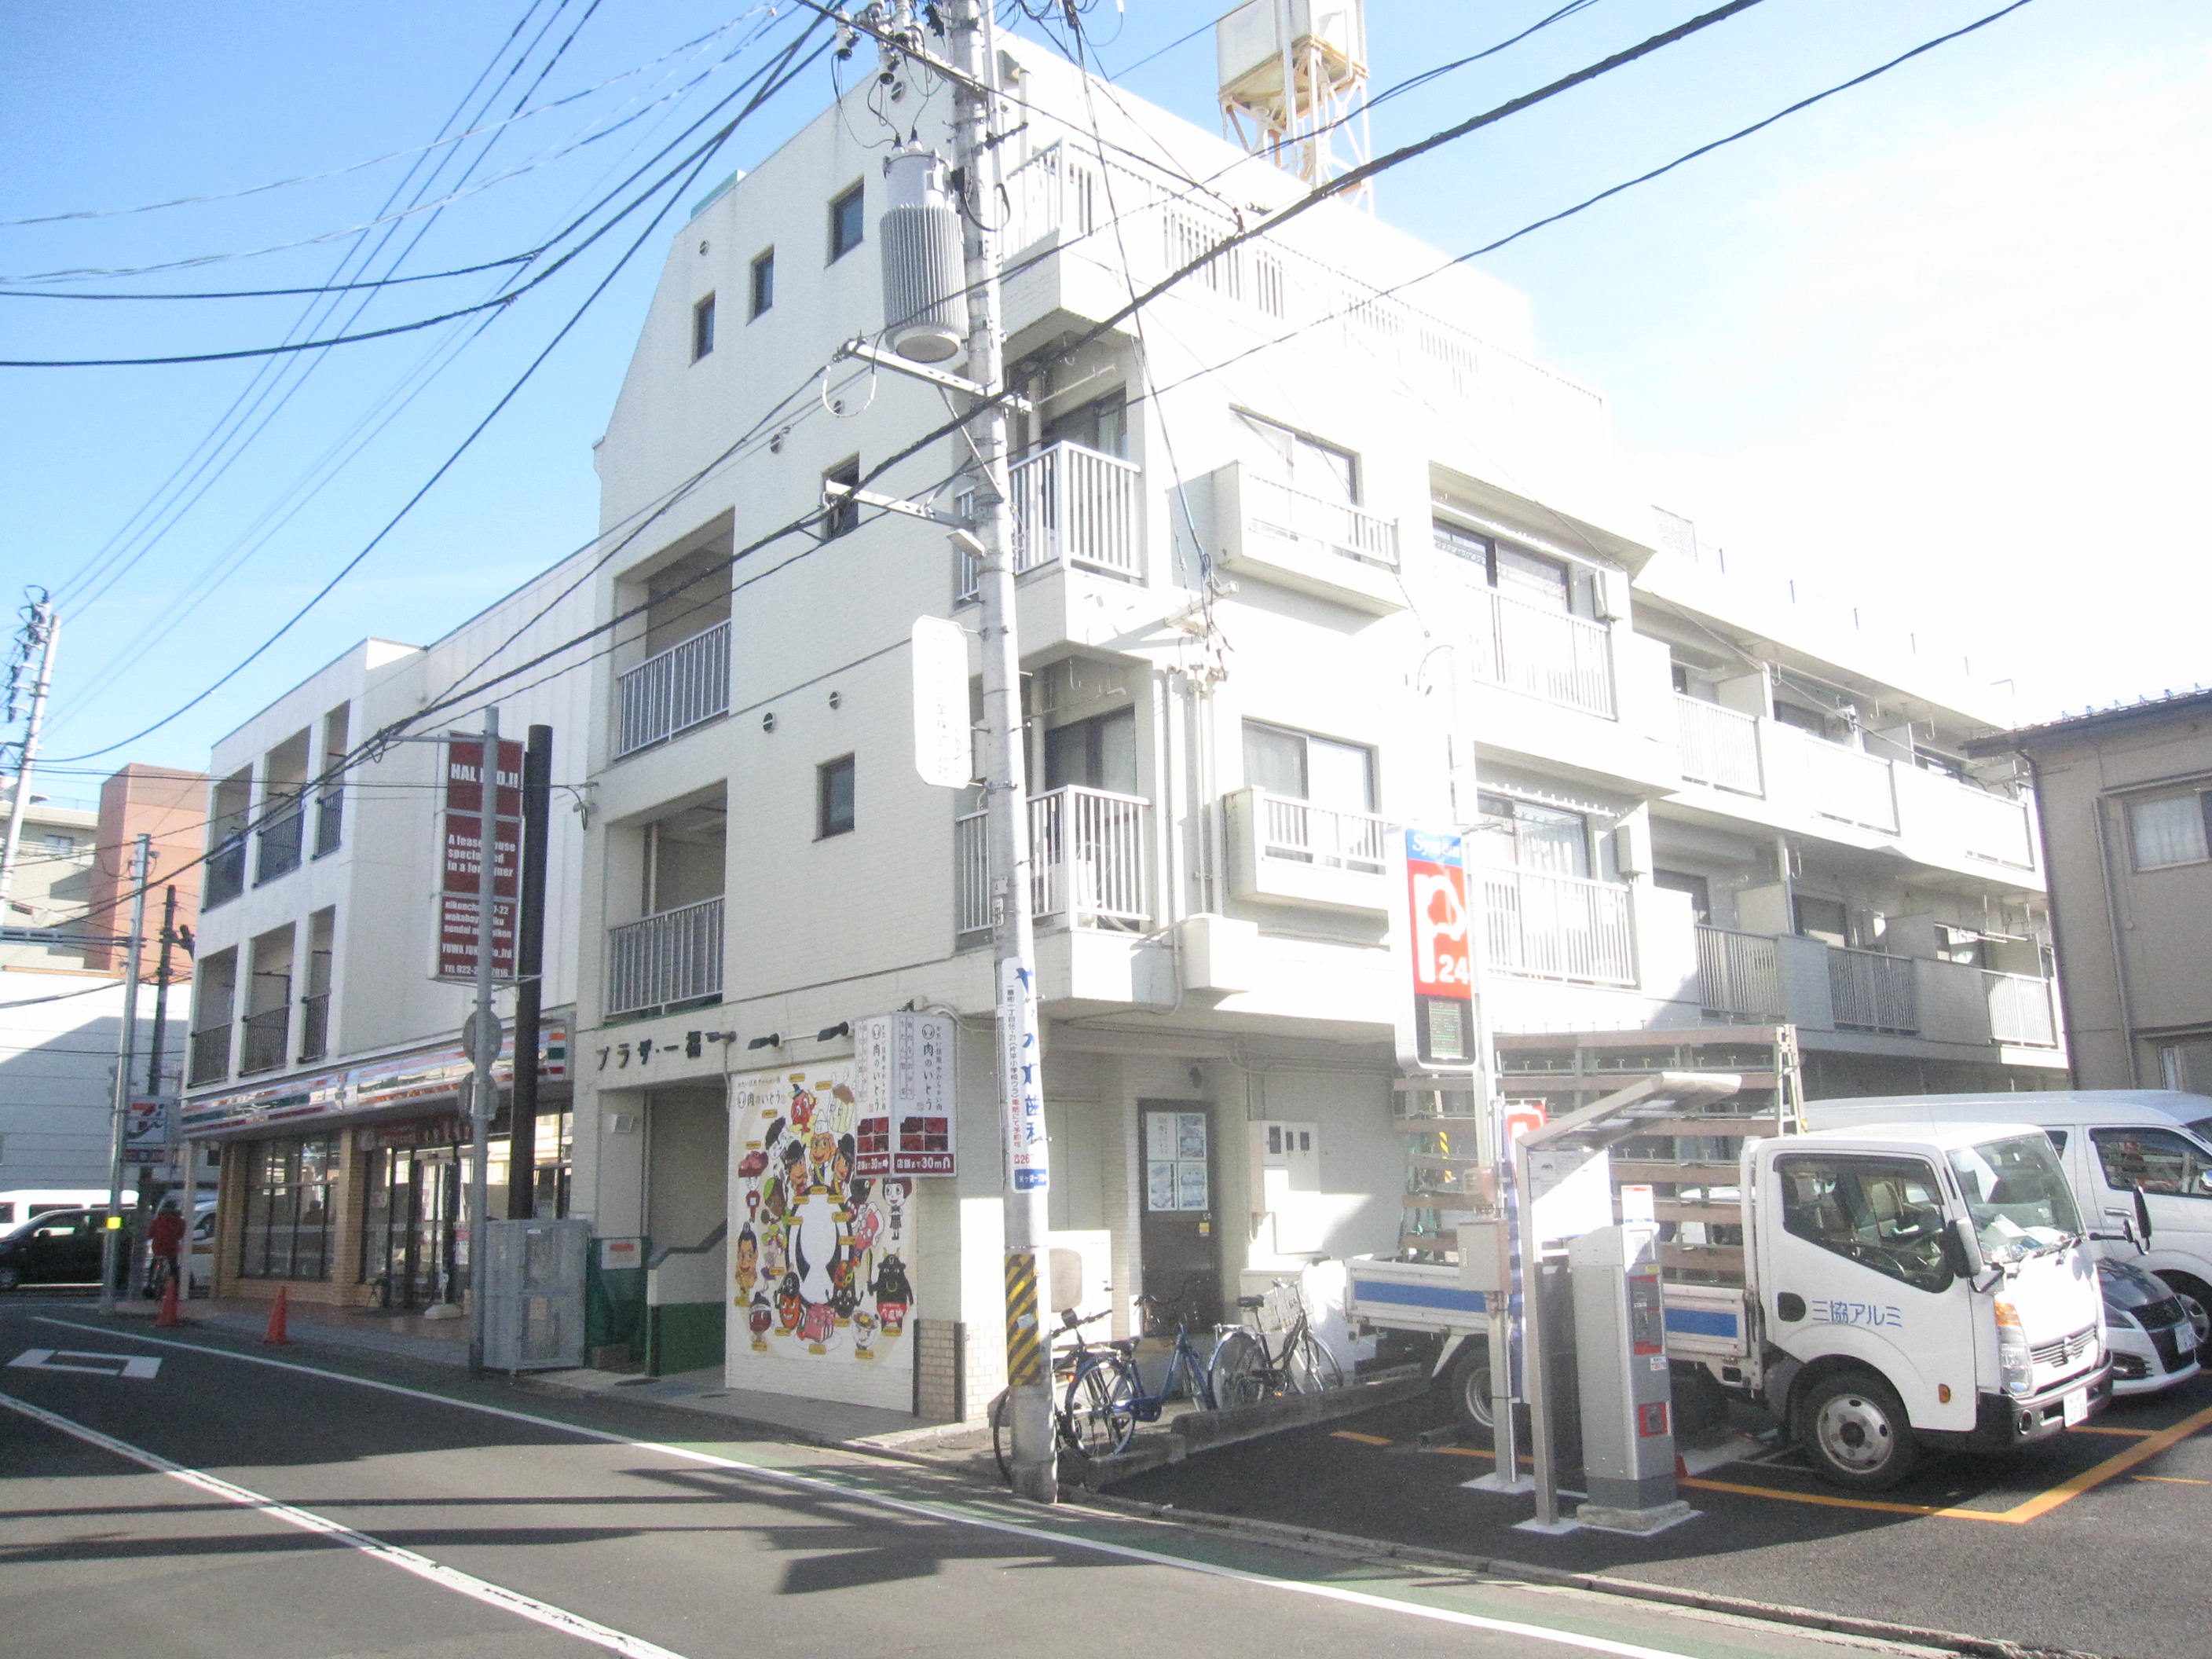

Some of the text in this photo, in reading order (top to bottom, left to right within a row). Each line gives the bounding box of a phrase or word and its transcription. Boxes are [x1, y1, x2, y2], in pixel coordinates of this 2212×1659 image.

[451, 764, 477, 782] HAL
[449, 834, 456, 844] A
[448, 860, 458, 871] in
[460, 863, 466, 872] a
[1438, 954, 1470, 984] 24
[923, 1042, 934, 1111] 肉のいとう
[1811, 1300, 1903, 1328] 三協アルミ
